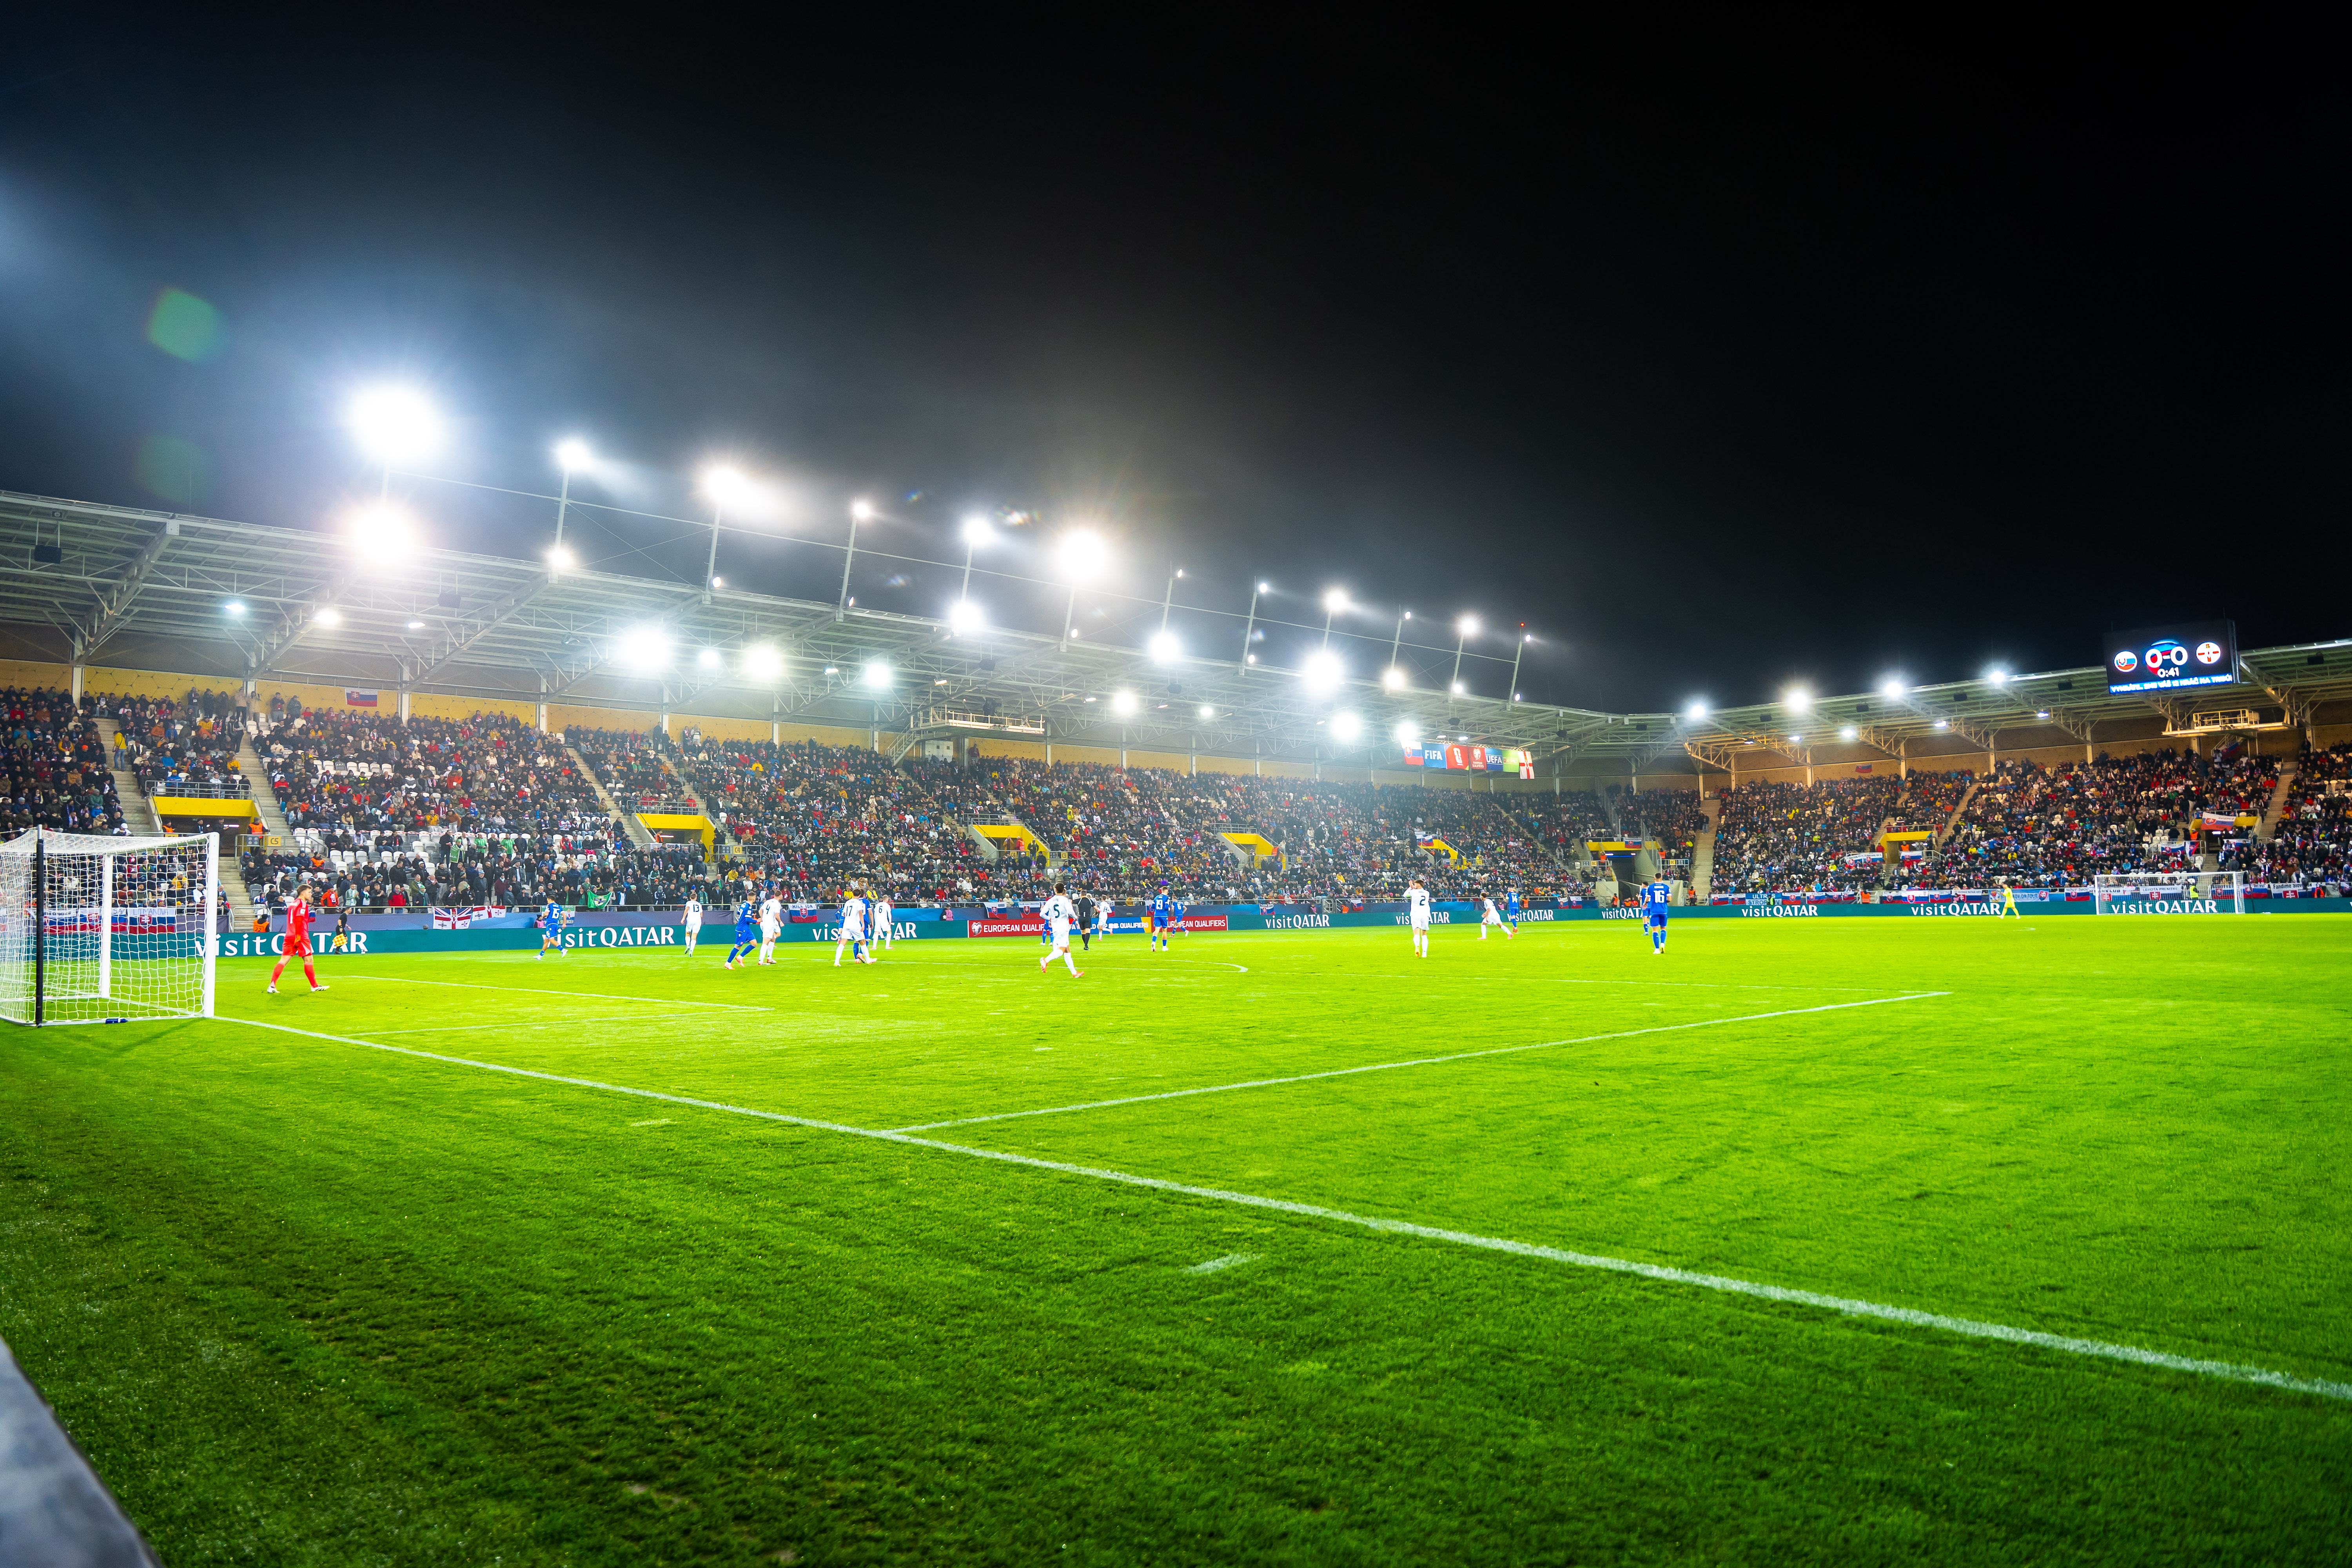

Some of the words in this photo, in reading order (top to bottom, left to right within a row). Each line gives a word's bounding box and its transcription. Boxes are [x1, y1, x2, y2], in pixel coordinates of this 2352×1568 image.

[2157, 667, 2179, 678] 0:41
[1425, 750, 1443, 760] FIFA
[1486, 755, 1503, 764] UEFA
[1419, 895, 1426, 906] 2
[1653, 890, 1665, 903] 16
[766, 904, 770, 914] 4
[1156, 899, 1163, 910] 19
[289, 908, 293, 924] 1
[846, 906, 853, 916] 17
[1053, 904, 1060, 918] 5
[1507, 909, 1554, 922] vsitQATAR
[1601, 907, 1643, 919] visitQAT
[984, 924, 1020, 933] EUROPEAN
[1022, 924, 1044, 932] QUALIF
